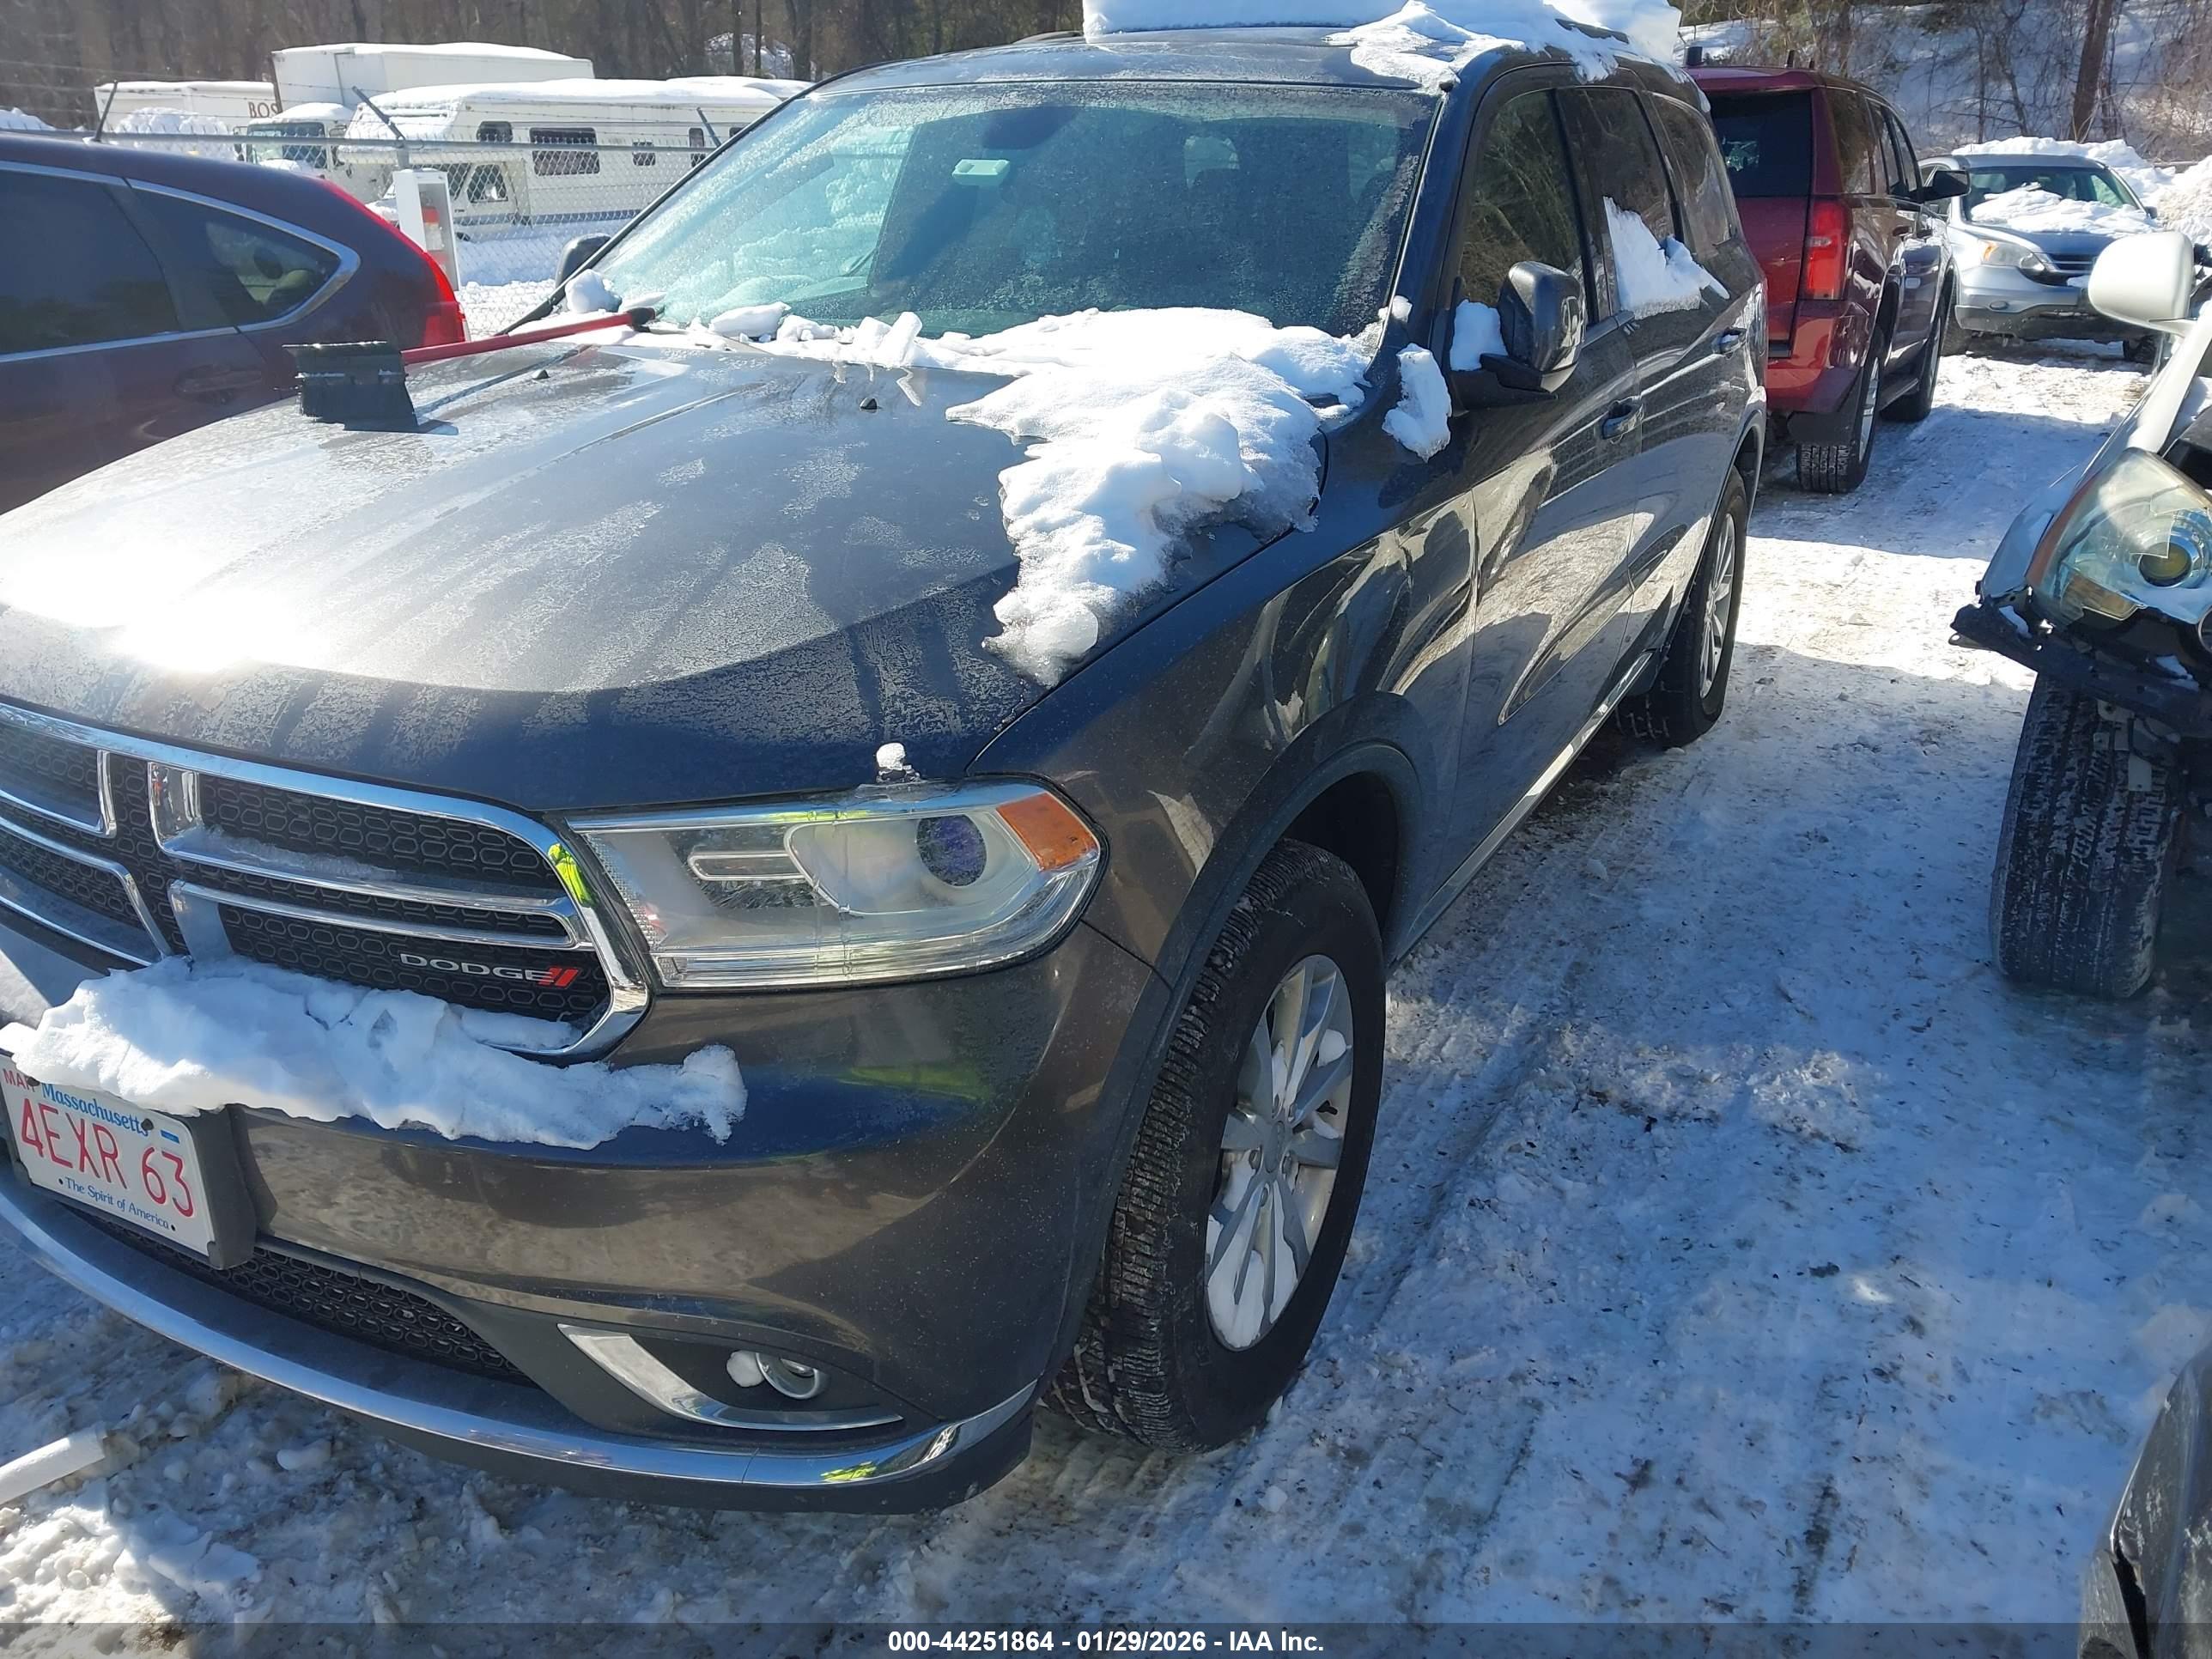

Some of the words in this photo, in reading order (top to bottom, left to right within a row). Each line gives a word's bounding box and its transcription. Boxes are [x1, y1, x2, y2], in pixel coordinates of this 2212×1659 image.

[399, 953, 555, 983] DODGE
[21, 1098, 128, 1189] 4EXR
[142, 1146, 194, 1218] 63
[65, 1176, 85, 1194] The
[87, 1185, 114, 1206] Spirit
[117, 1199, 126, 1212] of
[129, 1202, 169, 1230] America
